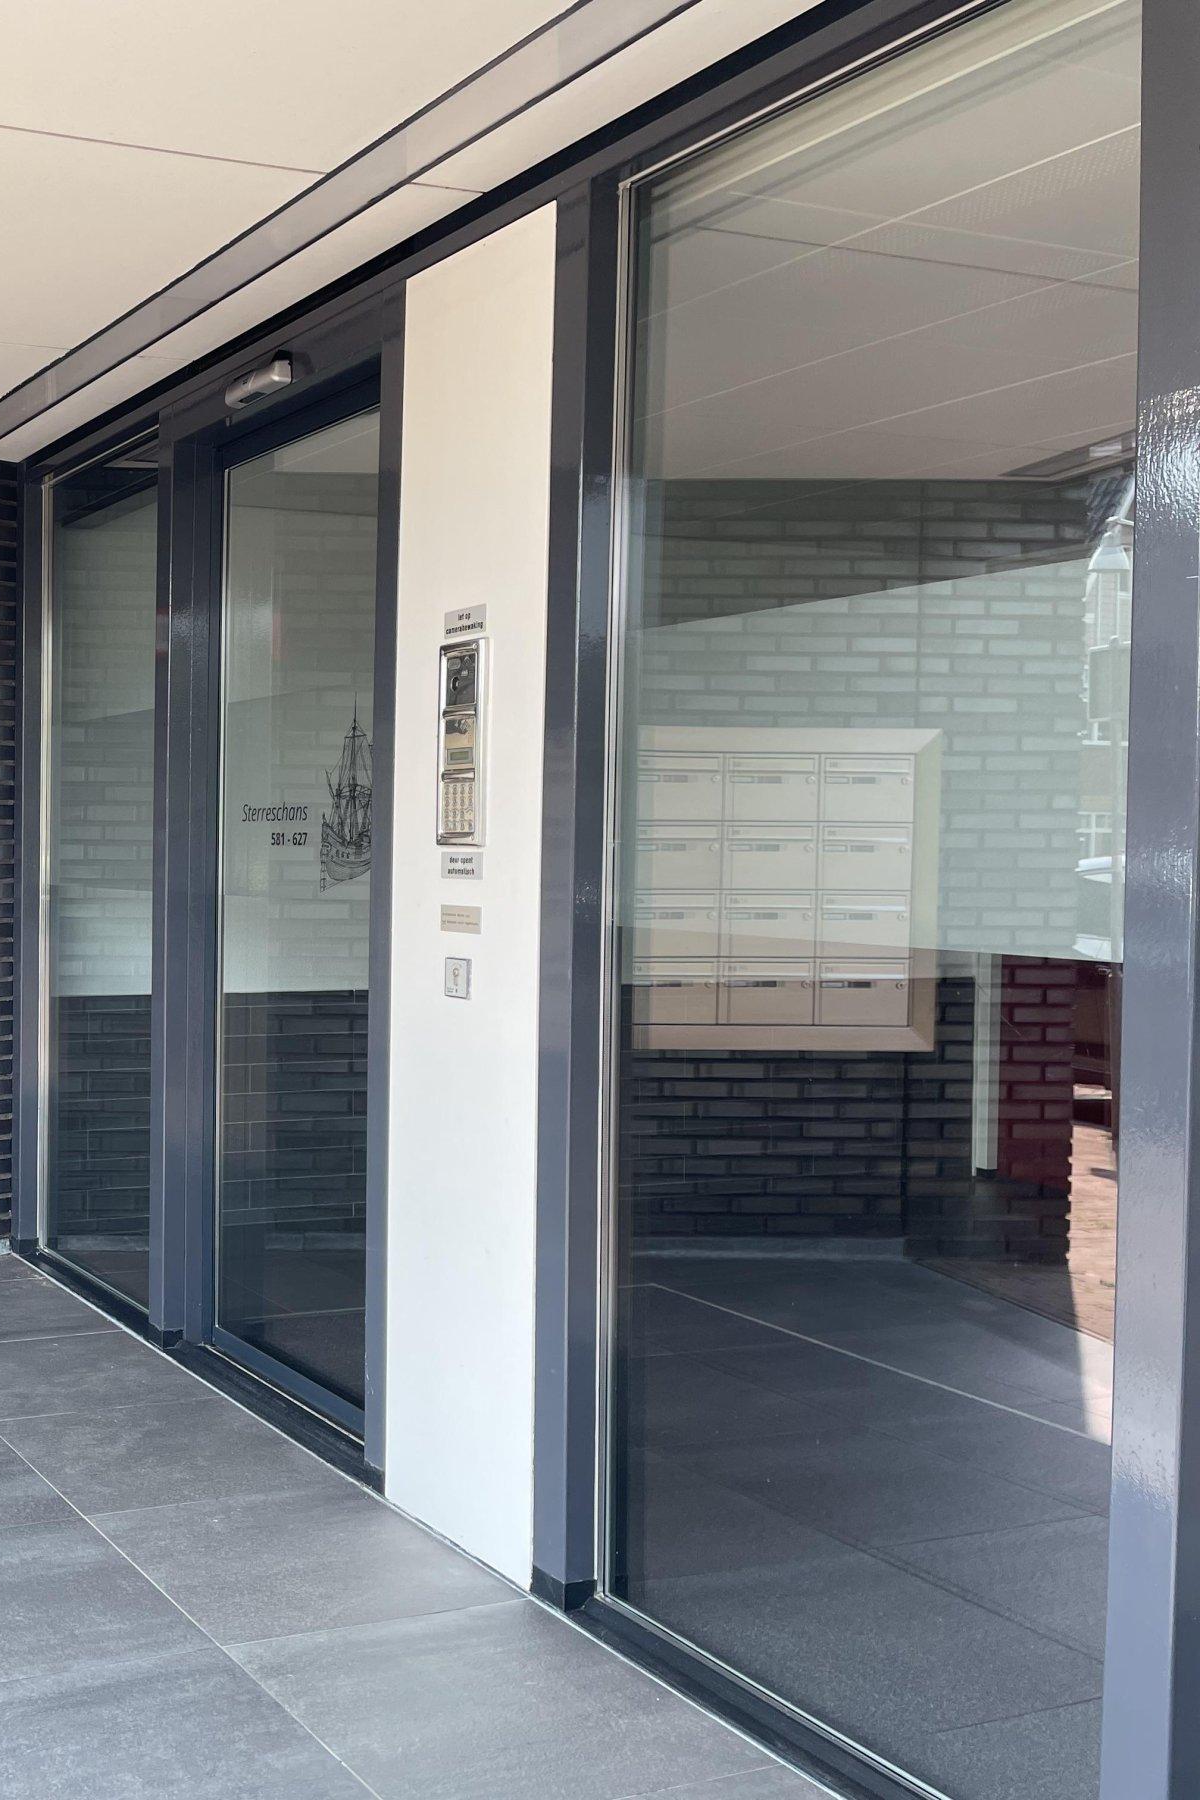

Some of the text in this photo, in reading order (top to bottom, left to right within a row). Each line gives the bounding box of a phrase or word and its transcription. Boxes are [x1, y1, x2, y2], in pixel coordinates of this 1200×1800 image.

[465, 612, 471, 621] op
[445, 621, 484, 635] camerabewaking
[241, 801, 308, 822] Sterreschans
[271, 832, 285, 846] 581
[292, 832, 308, 845] 627
[449, 856, 474, 865] deur opent
[447, 867, 475, 875] automatisch
